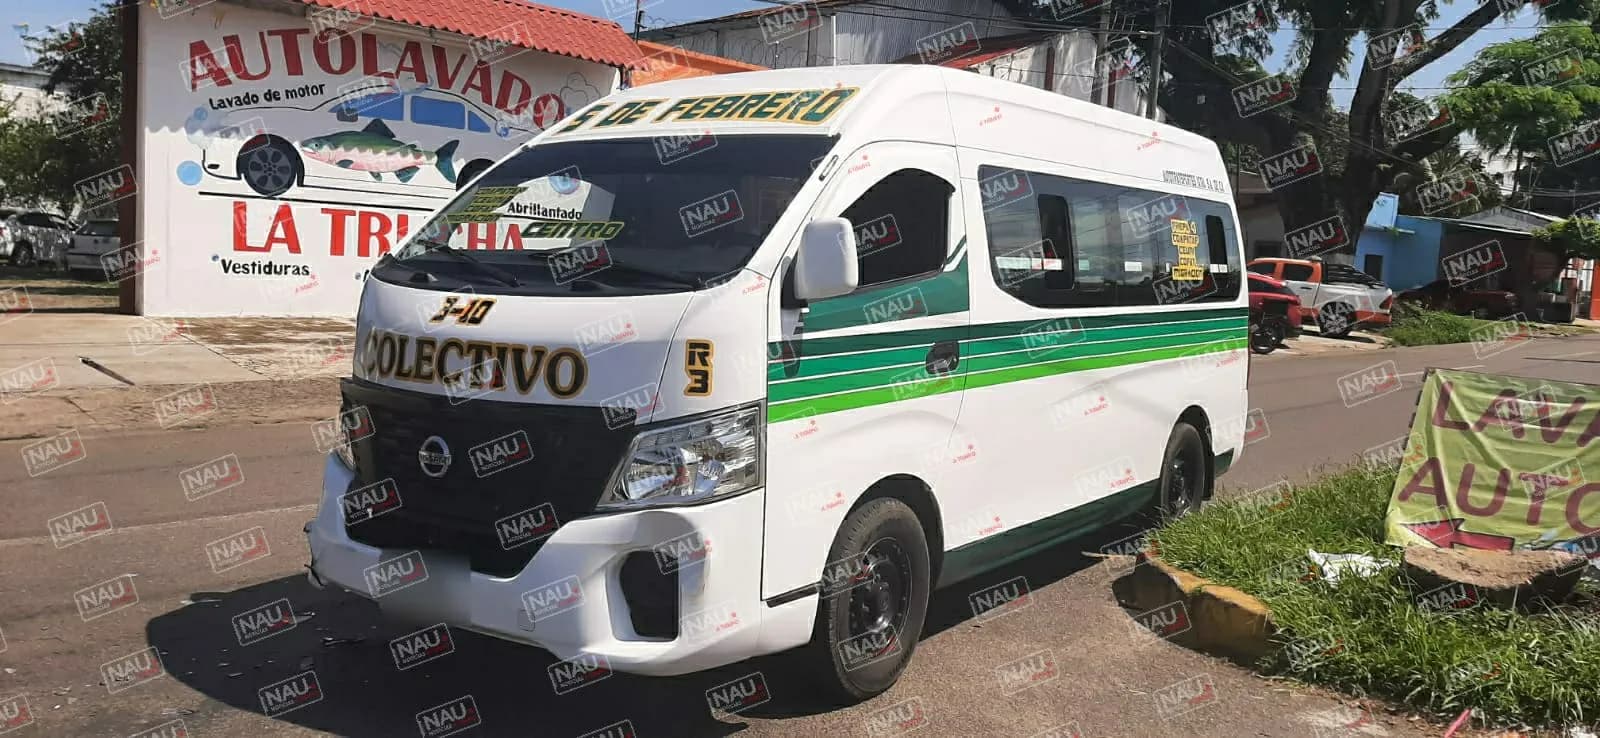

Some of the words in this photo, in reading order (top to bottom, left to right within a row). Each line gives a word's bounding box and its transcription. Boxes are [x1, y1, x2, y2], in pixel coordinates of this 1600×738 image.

[189, 27, 565, 130] AUTOLAVADO
[209, 93, 260, 110] Lavado
[263, 88, 281, 102] de
[285, 83, 326, 100] motor
[552, 103, 608, 135] 5
[592, 99, 671, 128] DE
[650, 86, 861, 125] FEBRERO
[507, 201, 583, 220] Abrillantado
[233, 201, 302, 254] LA
[519, 220, 626, 241] CENTRO
[220, 258, 310, 276] Vestiduras
[429, 295, 497, 327] 3-10
[363, 328, 589, 400] COLECTIVO
